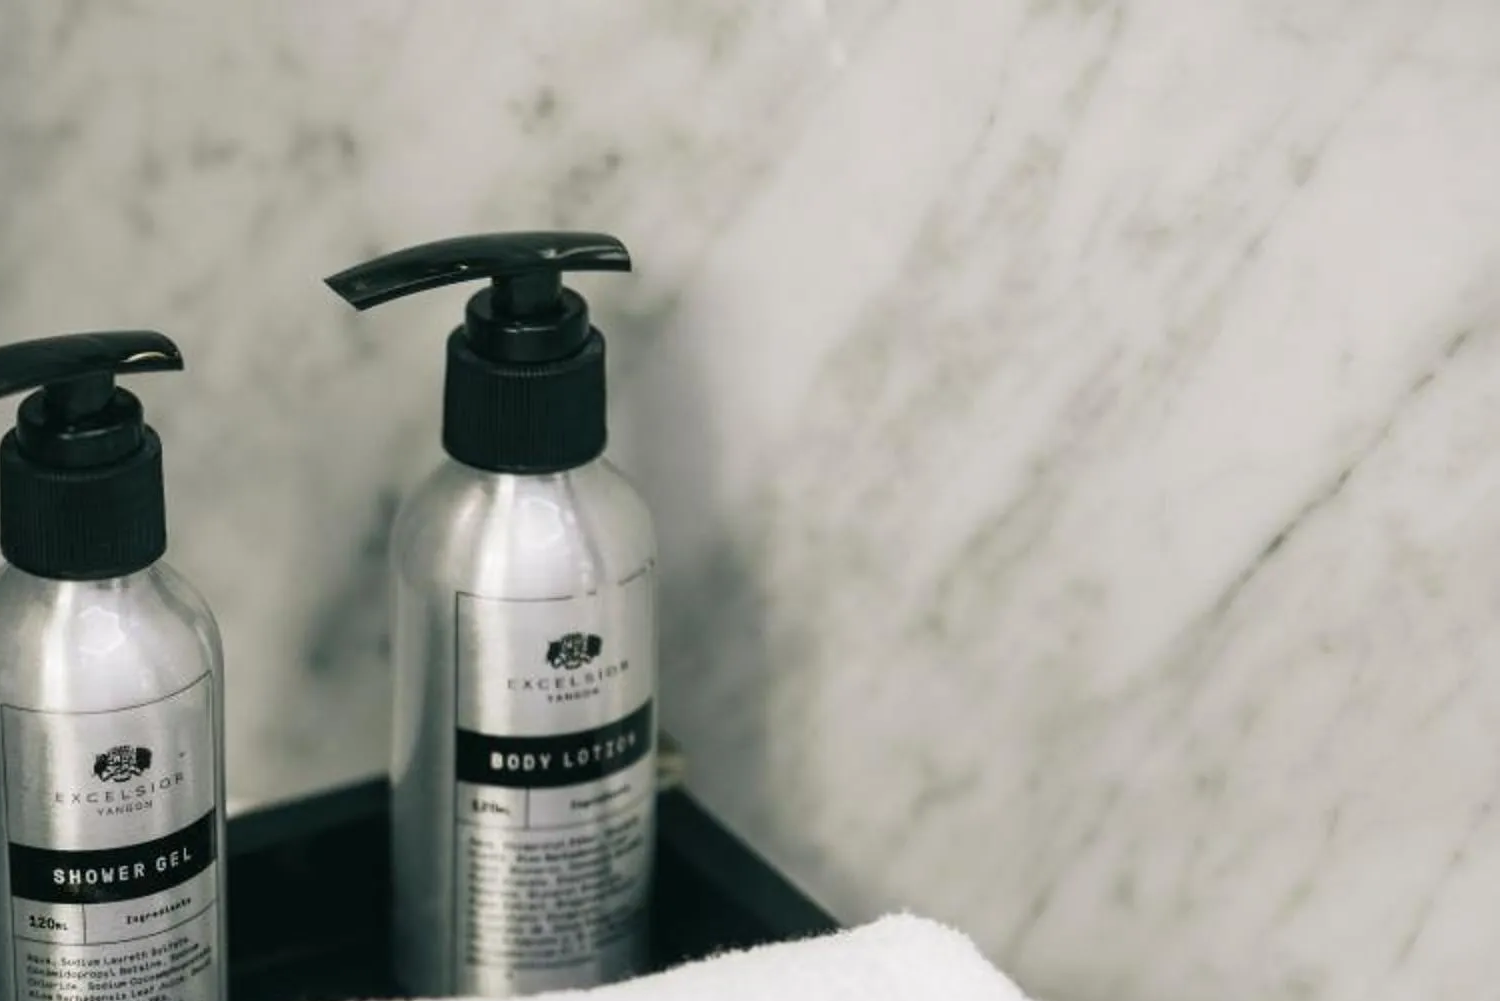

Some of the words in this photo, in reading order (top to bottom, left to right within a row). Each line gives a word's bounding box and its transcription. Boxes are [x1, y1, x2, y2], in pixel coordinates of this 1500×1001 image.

[508, 660, 629, 690] EXCELSIOR
[490, 751, 551, 771] BODY
[55, 772, 184, 803] EXCELSIOR
[97, 800, 153, 816] YANGON
[53, 863, 146, 885] SHOWER
[155, 847, 192, 872] GEL
